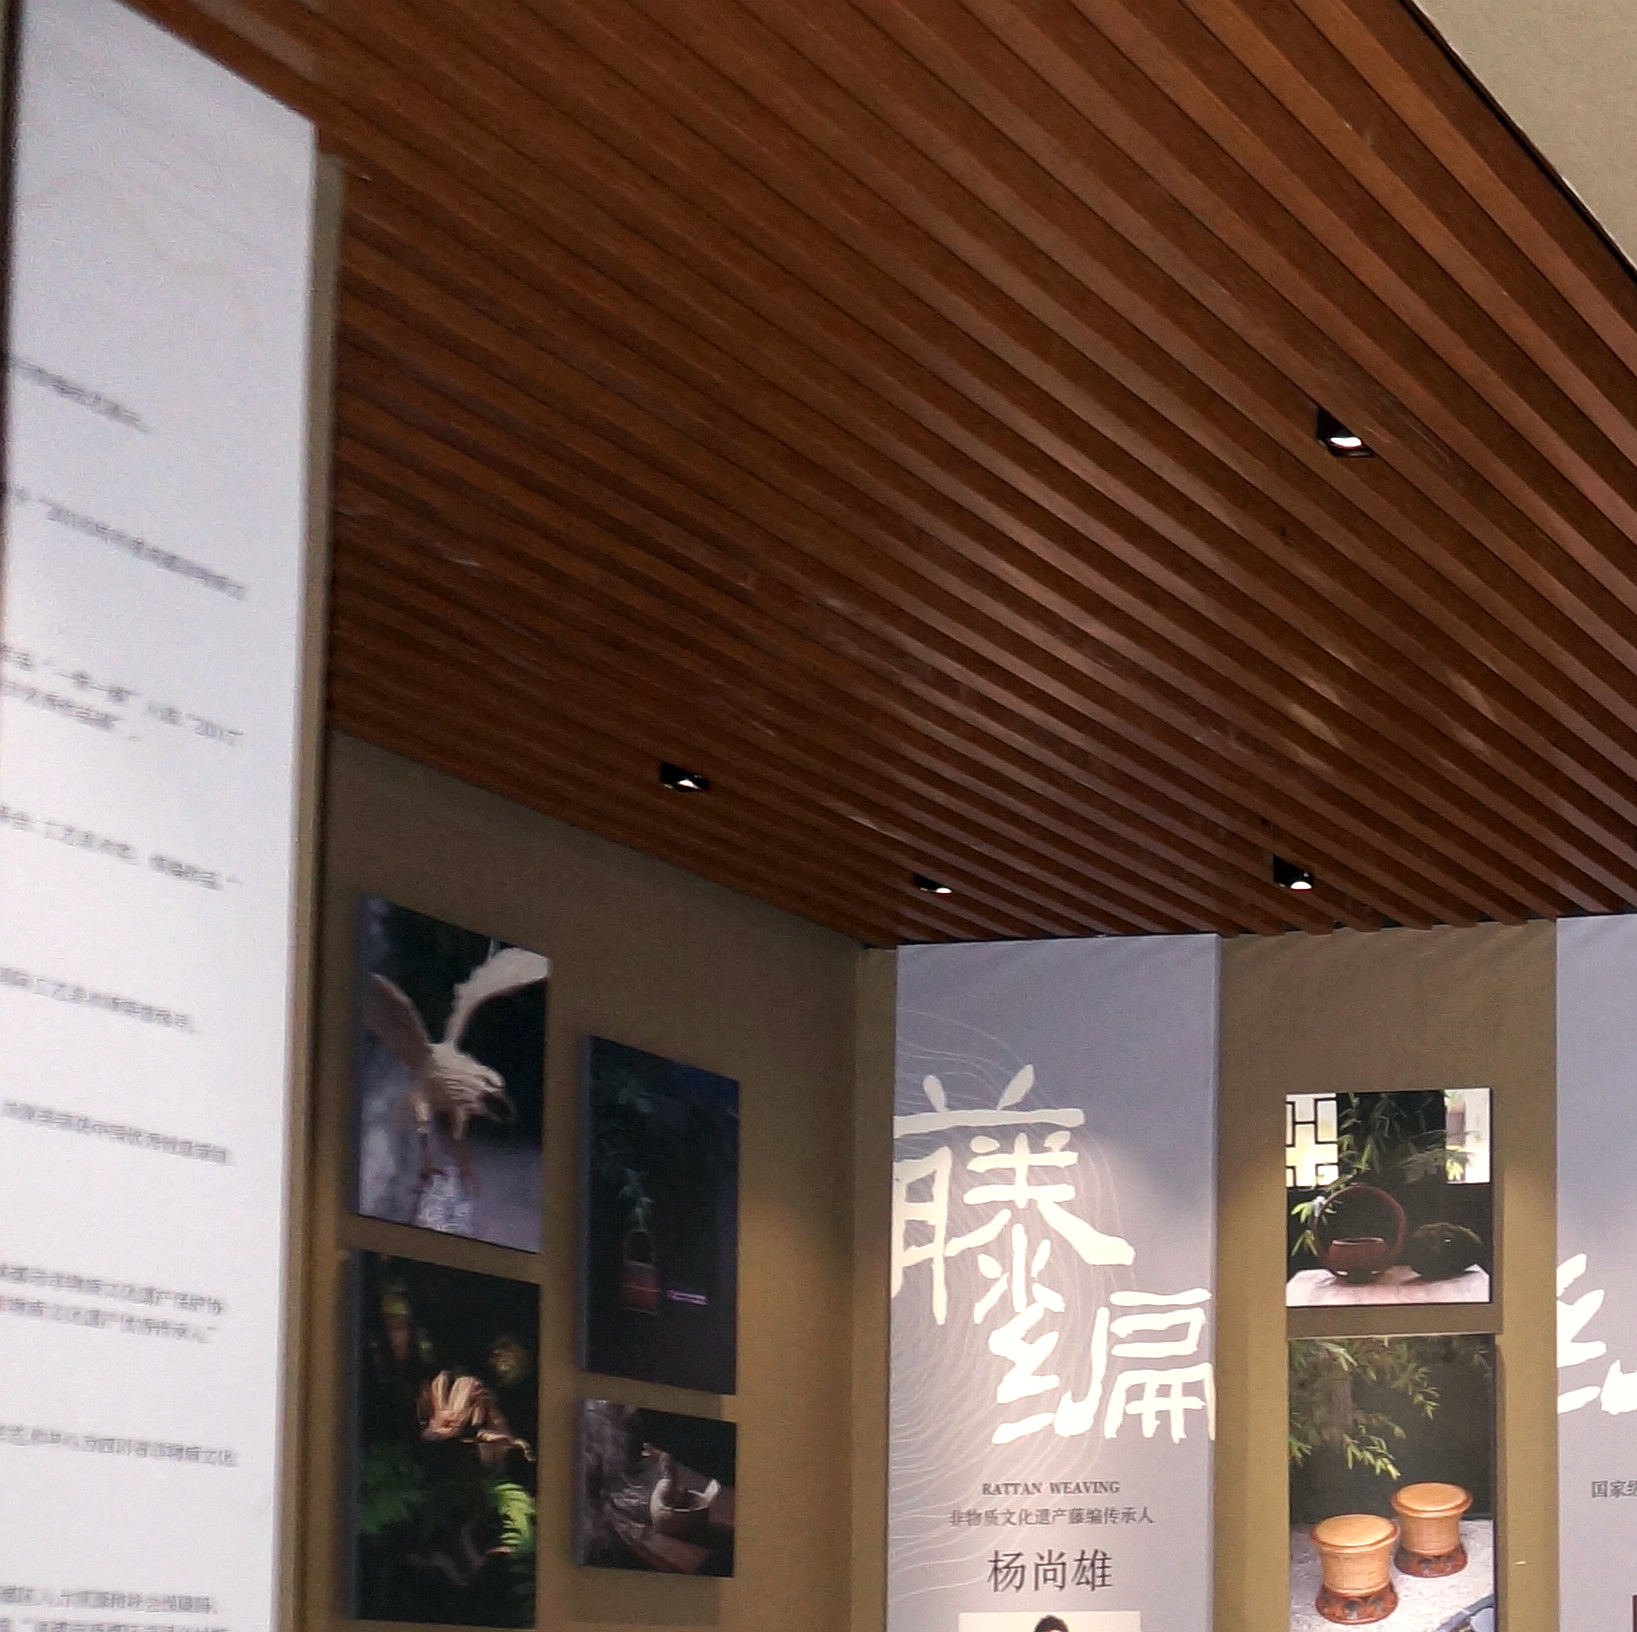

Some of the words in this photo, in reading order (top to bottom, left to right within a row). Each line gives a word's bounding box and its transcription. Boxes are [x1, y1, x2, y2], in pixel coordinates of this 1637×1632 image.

[981, 1482, 1043, 1496] RATTAN
[1049, 1480, 1121, 1495] WEAVING
[949, 1506, 1155, 1527] 非物质文化遗产藤编传承人
[986, 1548, 1114, 1593] 杨尚雄
